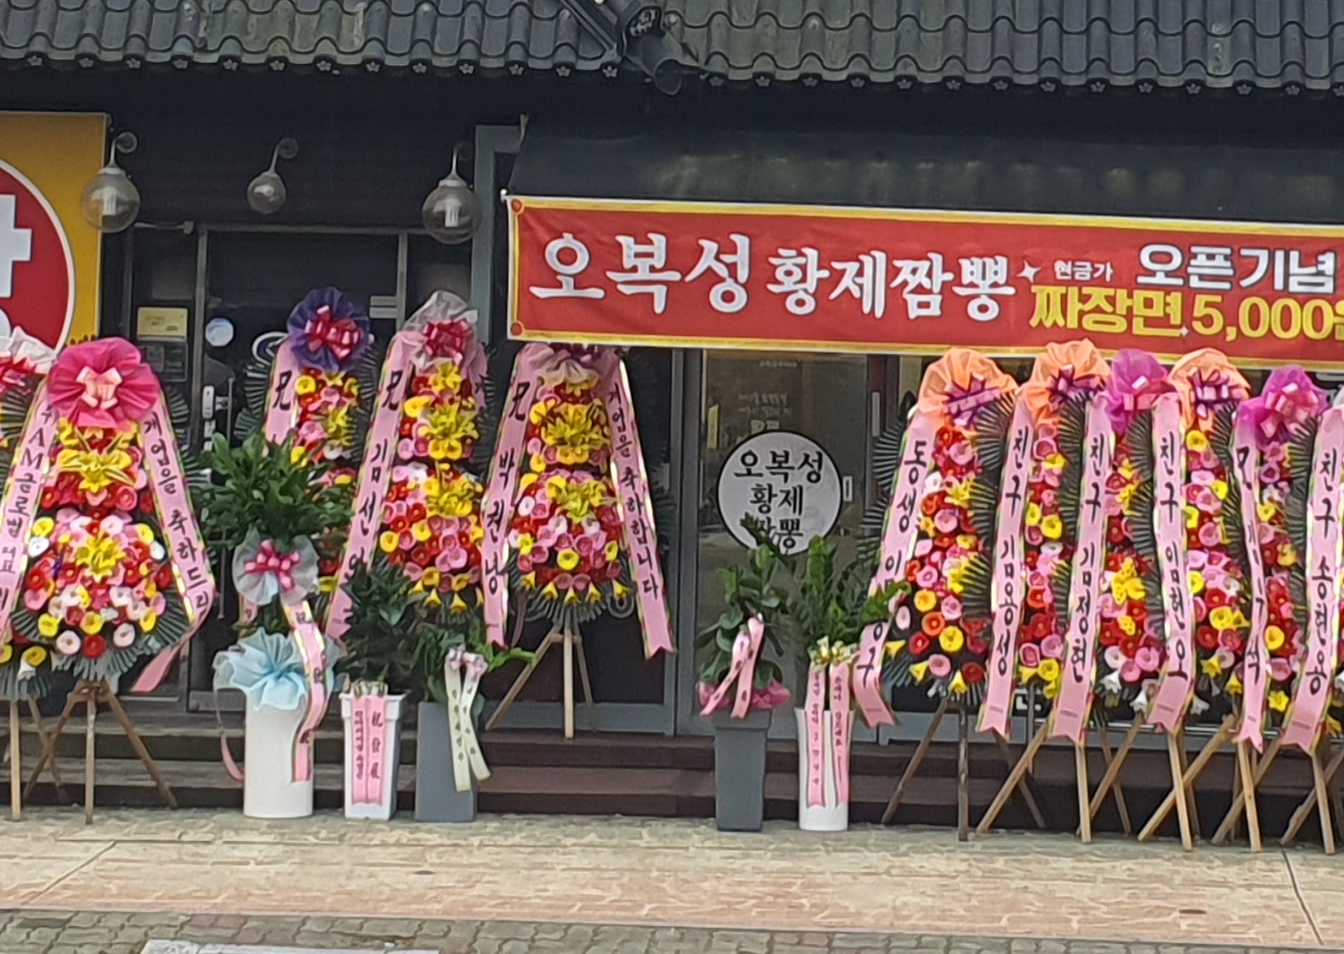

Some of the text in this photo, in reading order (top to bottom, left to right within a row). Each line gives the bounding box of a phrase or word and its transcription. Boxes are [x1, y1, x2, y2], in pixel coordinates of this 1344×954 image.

[529, 232, 1017, 323] 오복성 황제짬뽕
[1028, 283, 1185, 336] 짜장면
[733, 448, 824, 484] 오복성
[749, 482, 805, 516] 황제
[896, 439, 928, 534] 동생
[1004, 425, 1029, 518] 친구
[1085, 432, 1105, 525] 친구
[1159, 431, 1179, 524] 친구
[1314, 447, 1338, 539] 친구
